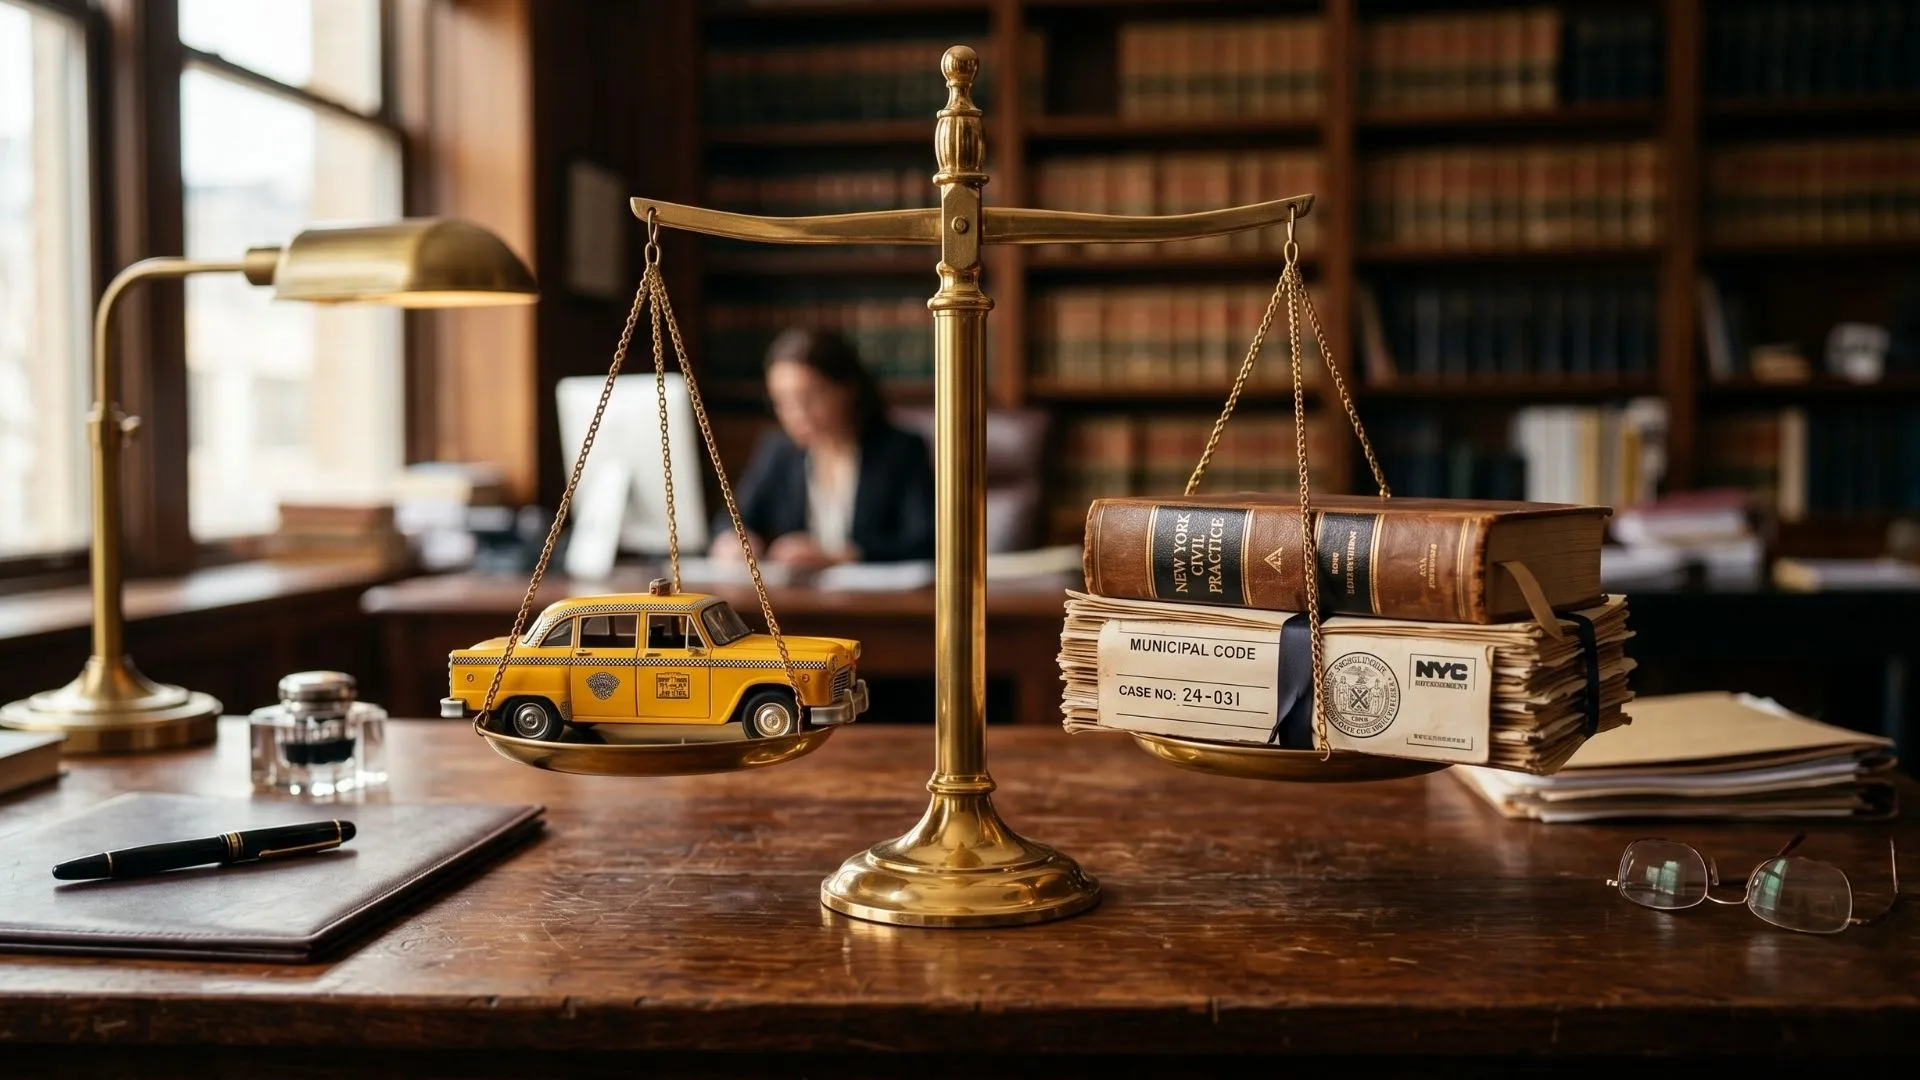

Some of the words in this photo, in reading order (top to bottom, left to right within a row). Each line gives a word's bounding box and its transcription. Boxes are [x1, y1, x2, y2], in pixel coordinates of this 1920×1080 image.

[1173, 513, 1191, 556] YORK
[1190, 535, 1205, 576] CIVIL
[1209, 517, 1225, 594] PRACTICE
[1173, 557, 1188, 593] NEW
[1130, 638, 1209, 656] MUNICIPAL
[1213, 645, 1256, 660] CODE
[1415, 660, 1468, 681] NYC
[1119, 685, 1151, 698] CASE
[1155, 688, 1176, 700] NO:
[1182, 688, 1240, 706] 24-031
